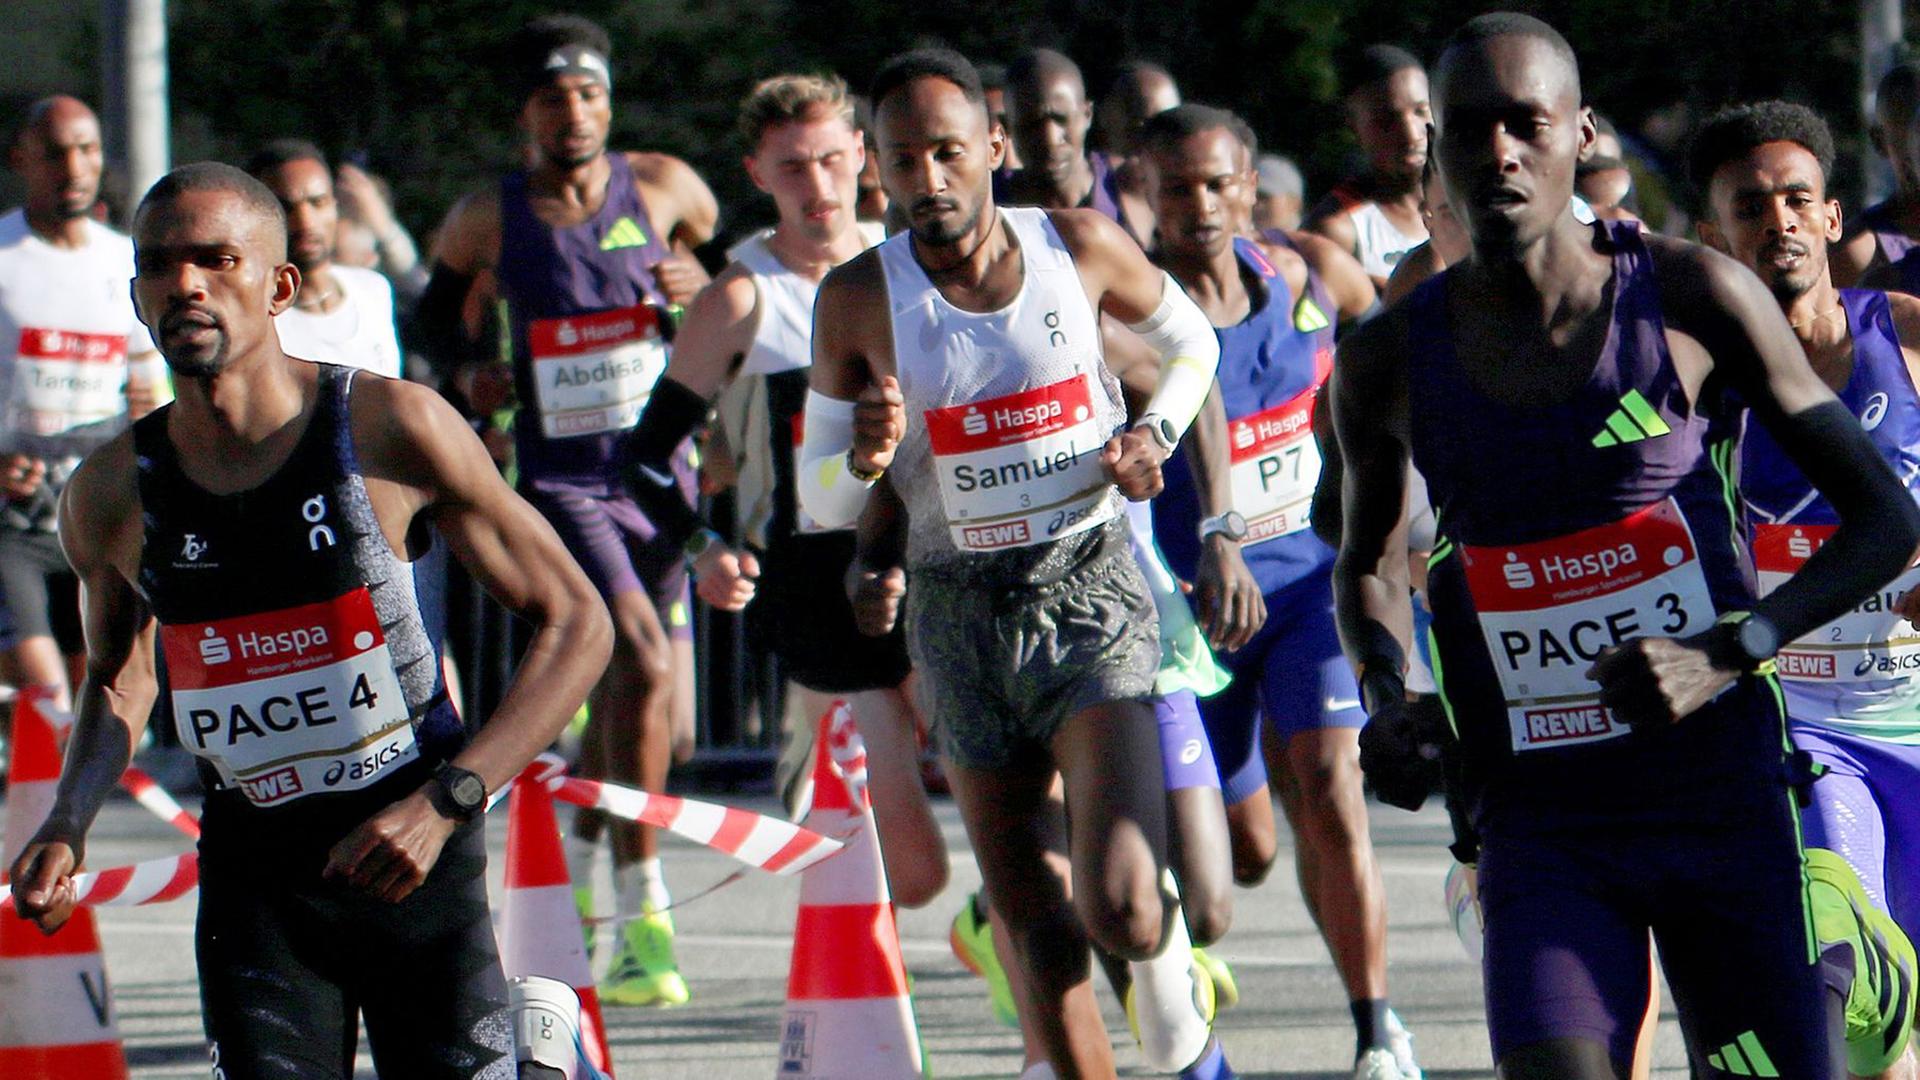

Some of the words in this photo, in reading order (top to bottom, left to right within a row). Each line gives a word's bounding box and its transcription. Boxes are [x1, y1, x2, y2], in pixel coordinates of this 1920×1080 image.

[554, 357, 644, 388] Abdisa
[993, 400, 1063, 430] Haspa
[1258, 408, 1308, 440] Haspa
[954, 440, 1079, 492] Samuel
[1258, 446, 1303, 493] P7
[1020, 493, 1031, 508] 3
[969, 524, 1027, 547] REWE
[1540, 543, 1638, 584] Haspa
[1655, 592, 1688, 634] 3
[237, 623, 329, 658] Haspa
[1831, 627, 1843, 642] 2
[1778, 656, 1832, 675] REWE
[189, 686, 337, 749] PACE
[349, 672, 378, 710] 4
[1528, 708, 1606, 739] REWE
[350, 741, 401, 781] asics
